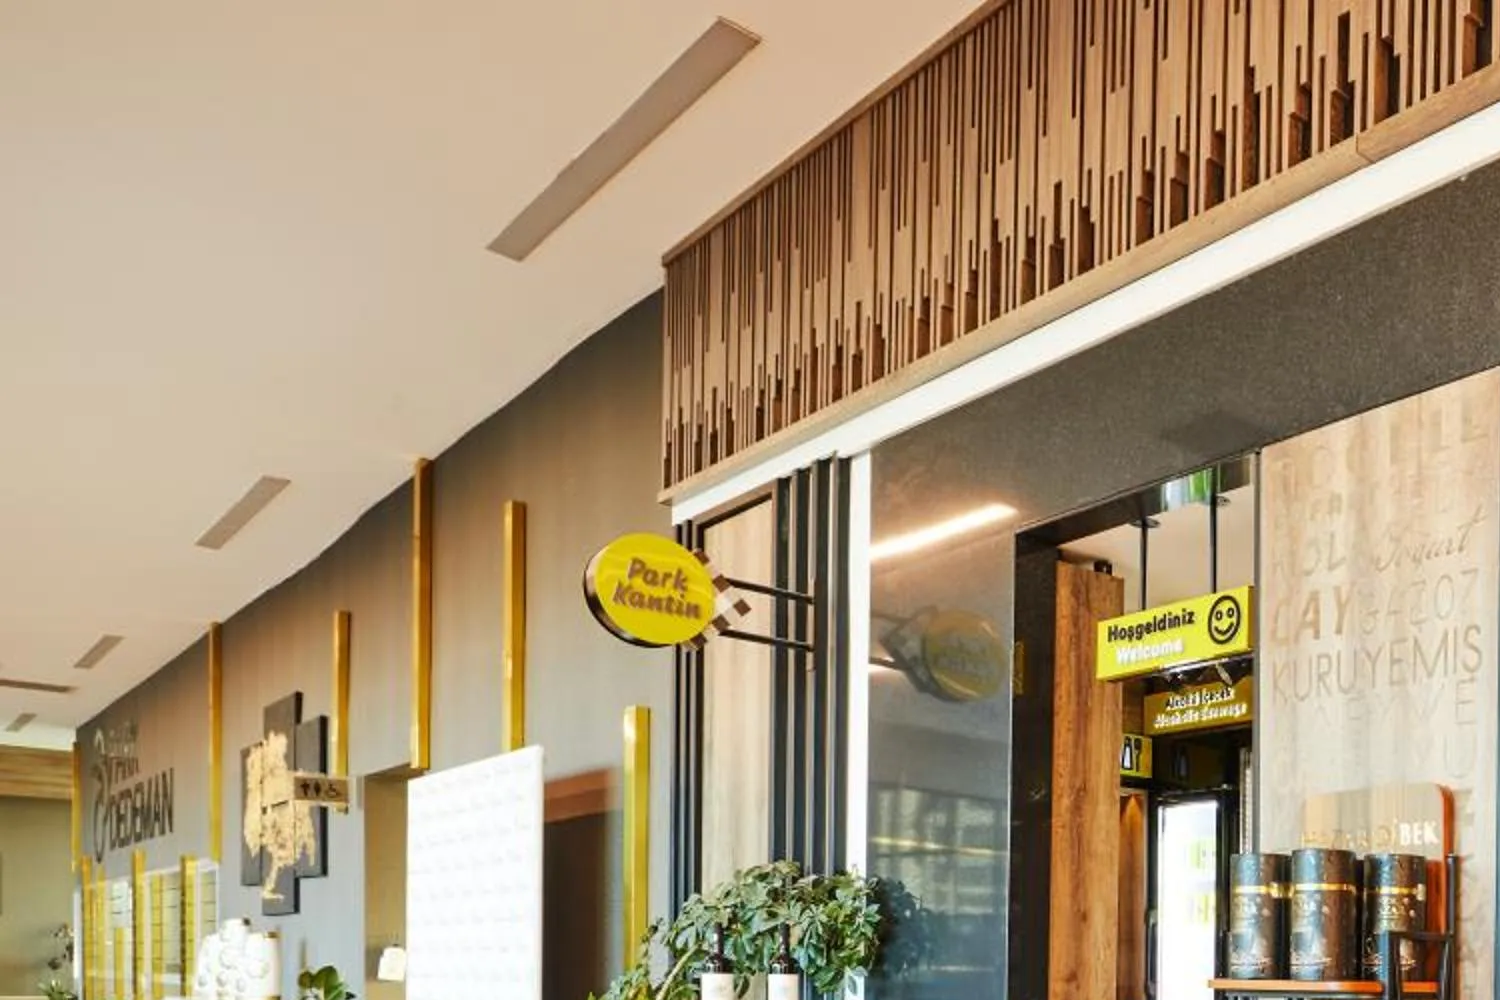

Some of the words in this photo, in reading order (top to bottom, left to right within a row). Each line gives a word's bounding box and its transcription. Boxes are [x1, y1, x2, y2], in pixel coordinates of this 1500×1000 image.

[627, 557, 689, 593] Park
[612, 579, 702, 620] Kantin
[1107, 608, 1195, 643] Hoşgeldiniz
[1116, 638, 1184, 666] Welcome
